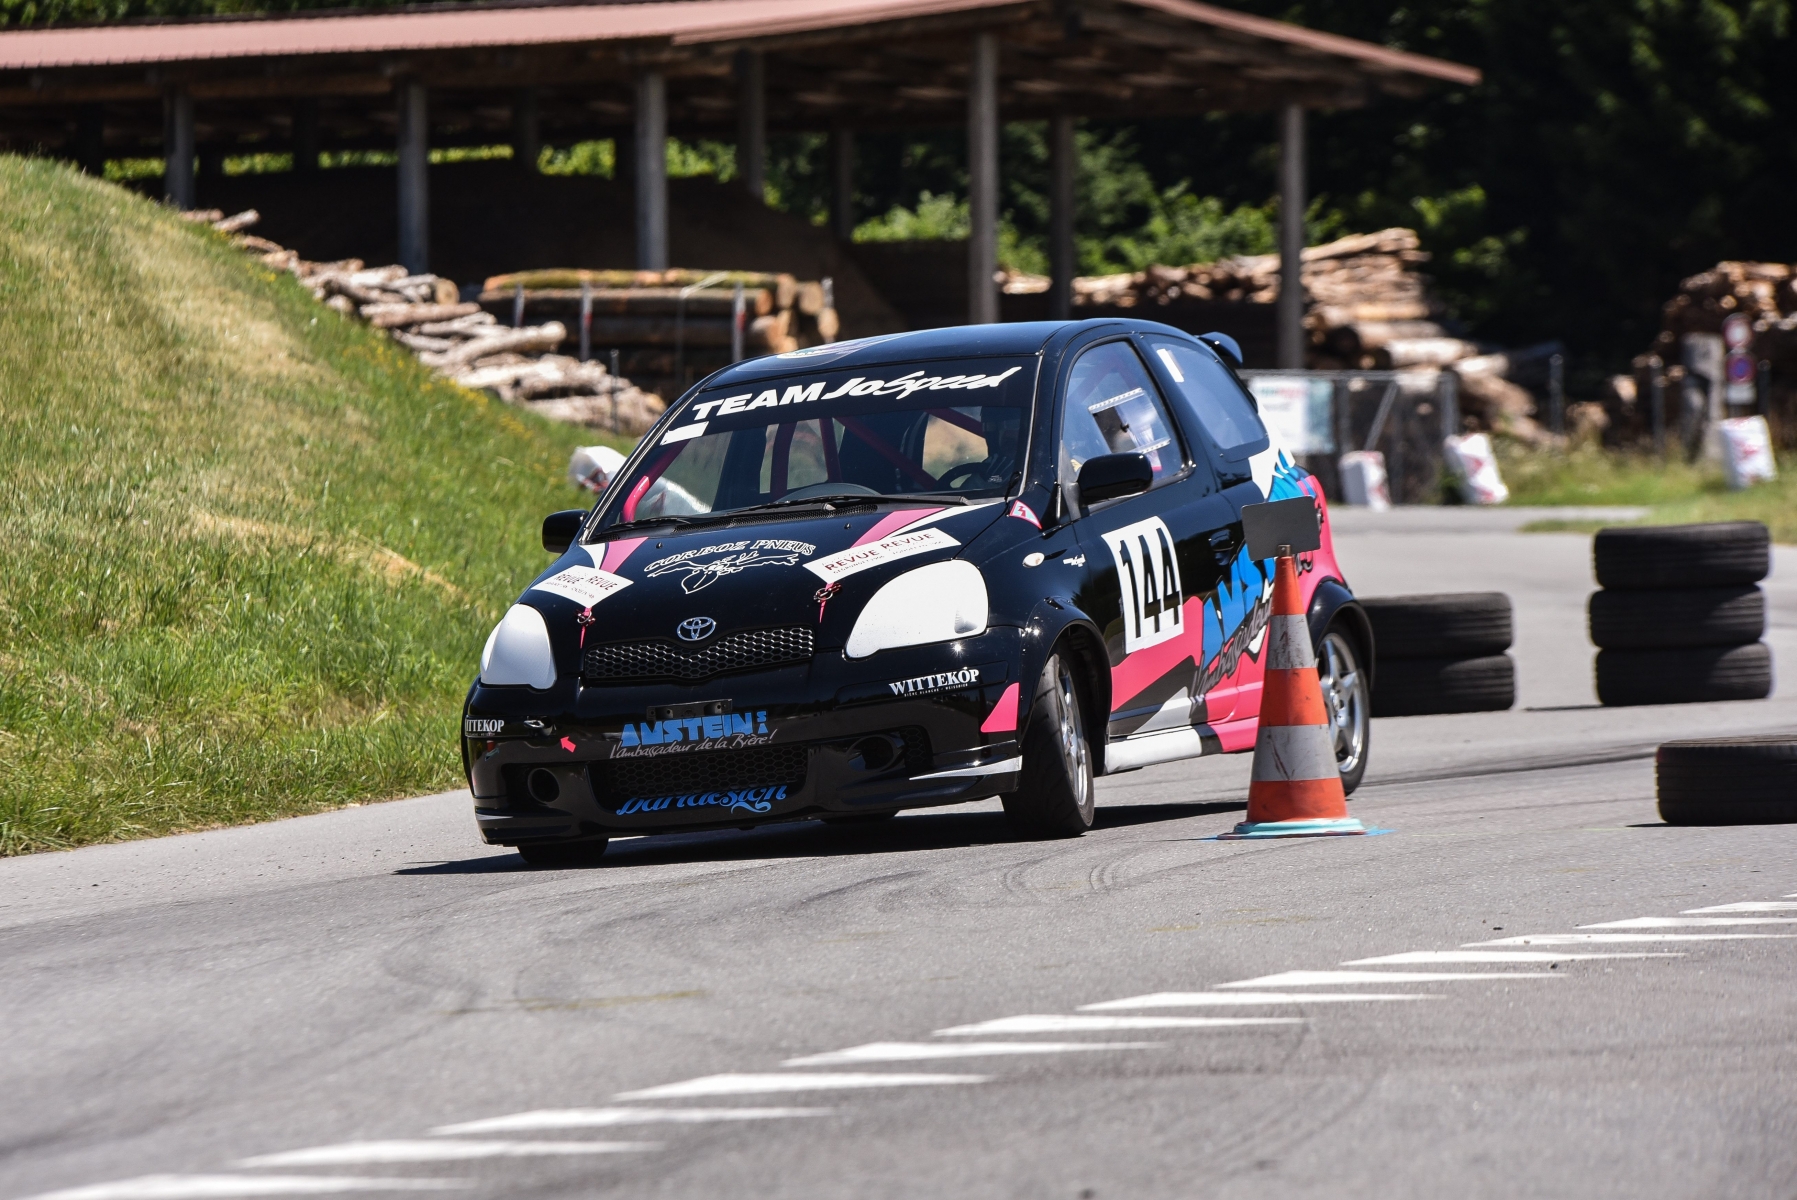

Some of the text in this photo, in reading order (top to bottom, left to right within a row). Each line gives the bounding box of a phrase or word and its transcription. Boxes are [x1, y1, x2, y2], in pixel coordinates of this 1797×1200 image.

[692, 366, 1022, 420] TEAM JoSpeed
[644, 540, 817, 572] CORBOZ PNEUS
[825, 549, 880, 571] REVUE
[880, 533, 935, 550] REVUE
[586, 575, 618, 591] REVUE
[1119, 527, 1180, 639] 144
[888, 669, 980, 696] WITTEKOP
[620, 712, 753, 748] AMSTEIN
[694, 737, 713, 751] de
[713, 735, 728, 749] la
